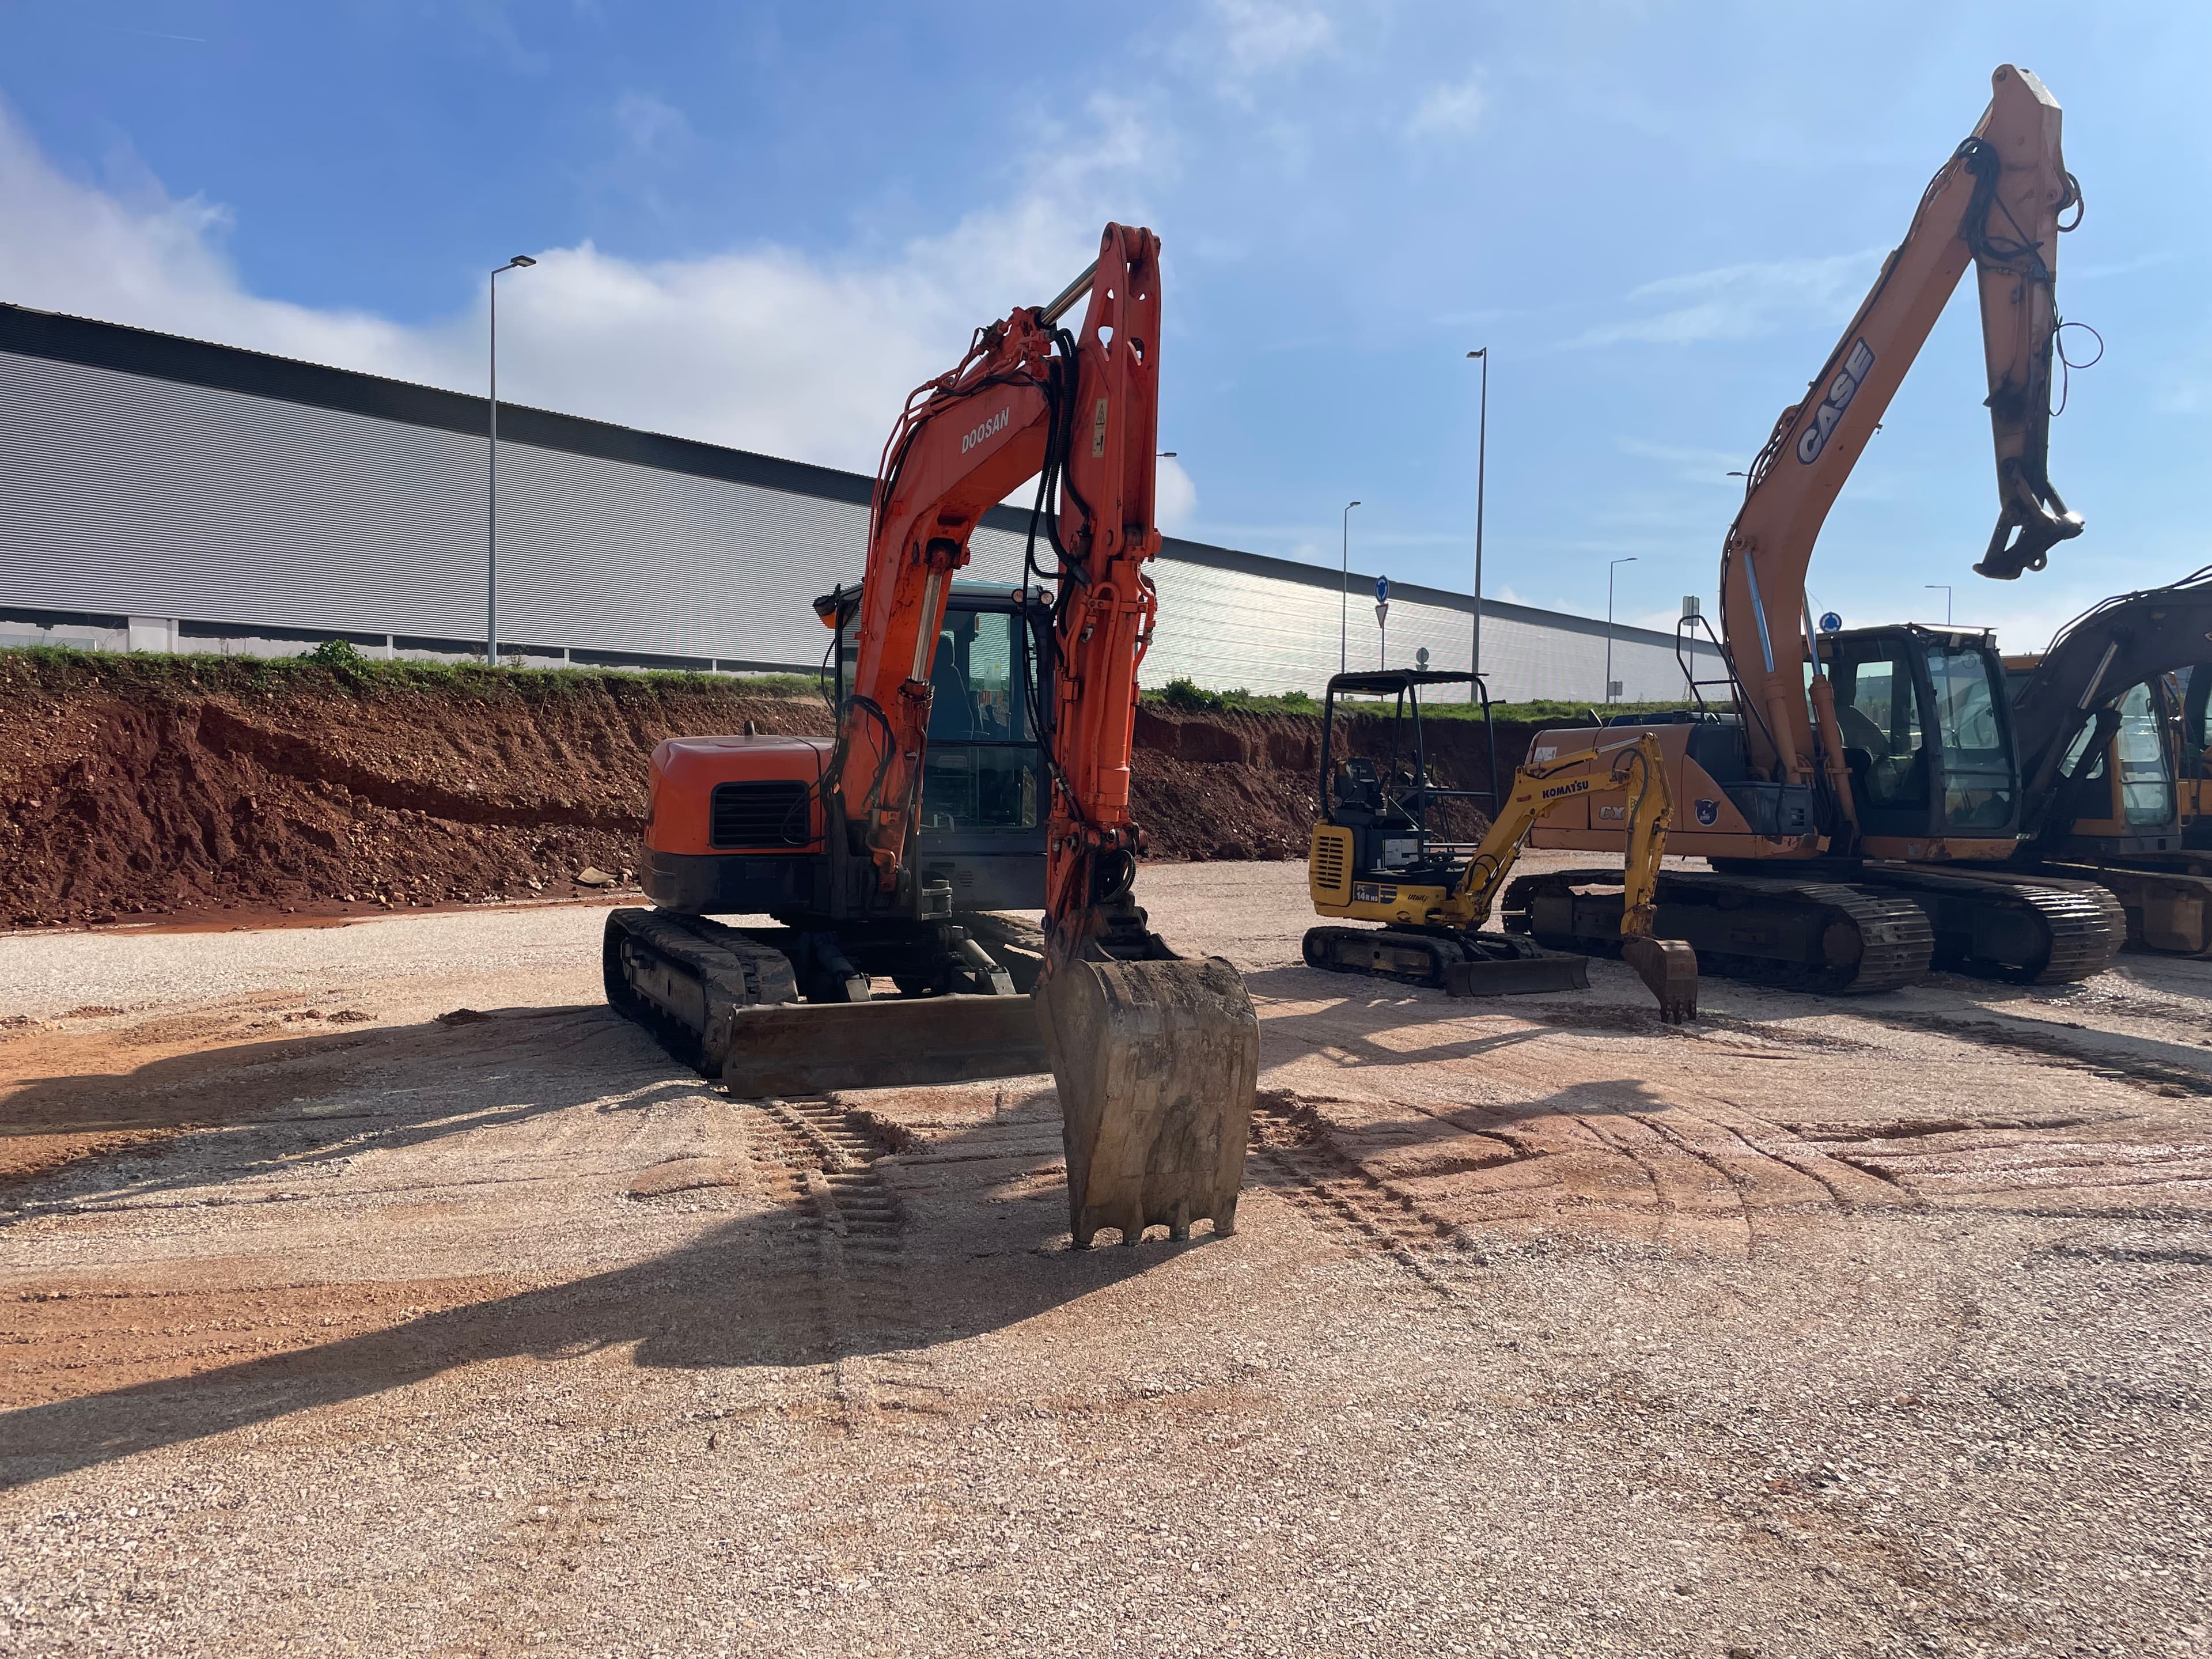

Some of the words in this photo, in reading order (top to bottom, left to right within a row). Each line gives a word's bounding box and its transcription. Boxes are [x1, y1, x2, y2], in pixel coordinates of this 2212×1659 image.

[1797, 337, 1876, 465] CASE
[961, 406, 1010, 454] DOOSAN
[1542, 780, 1589, 799] KOMATSU
[1599, 806, 1625, 820] CX
